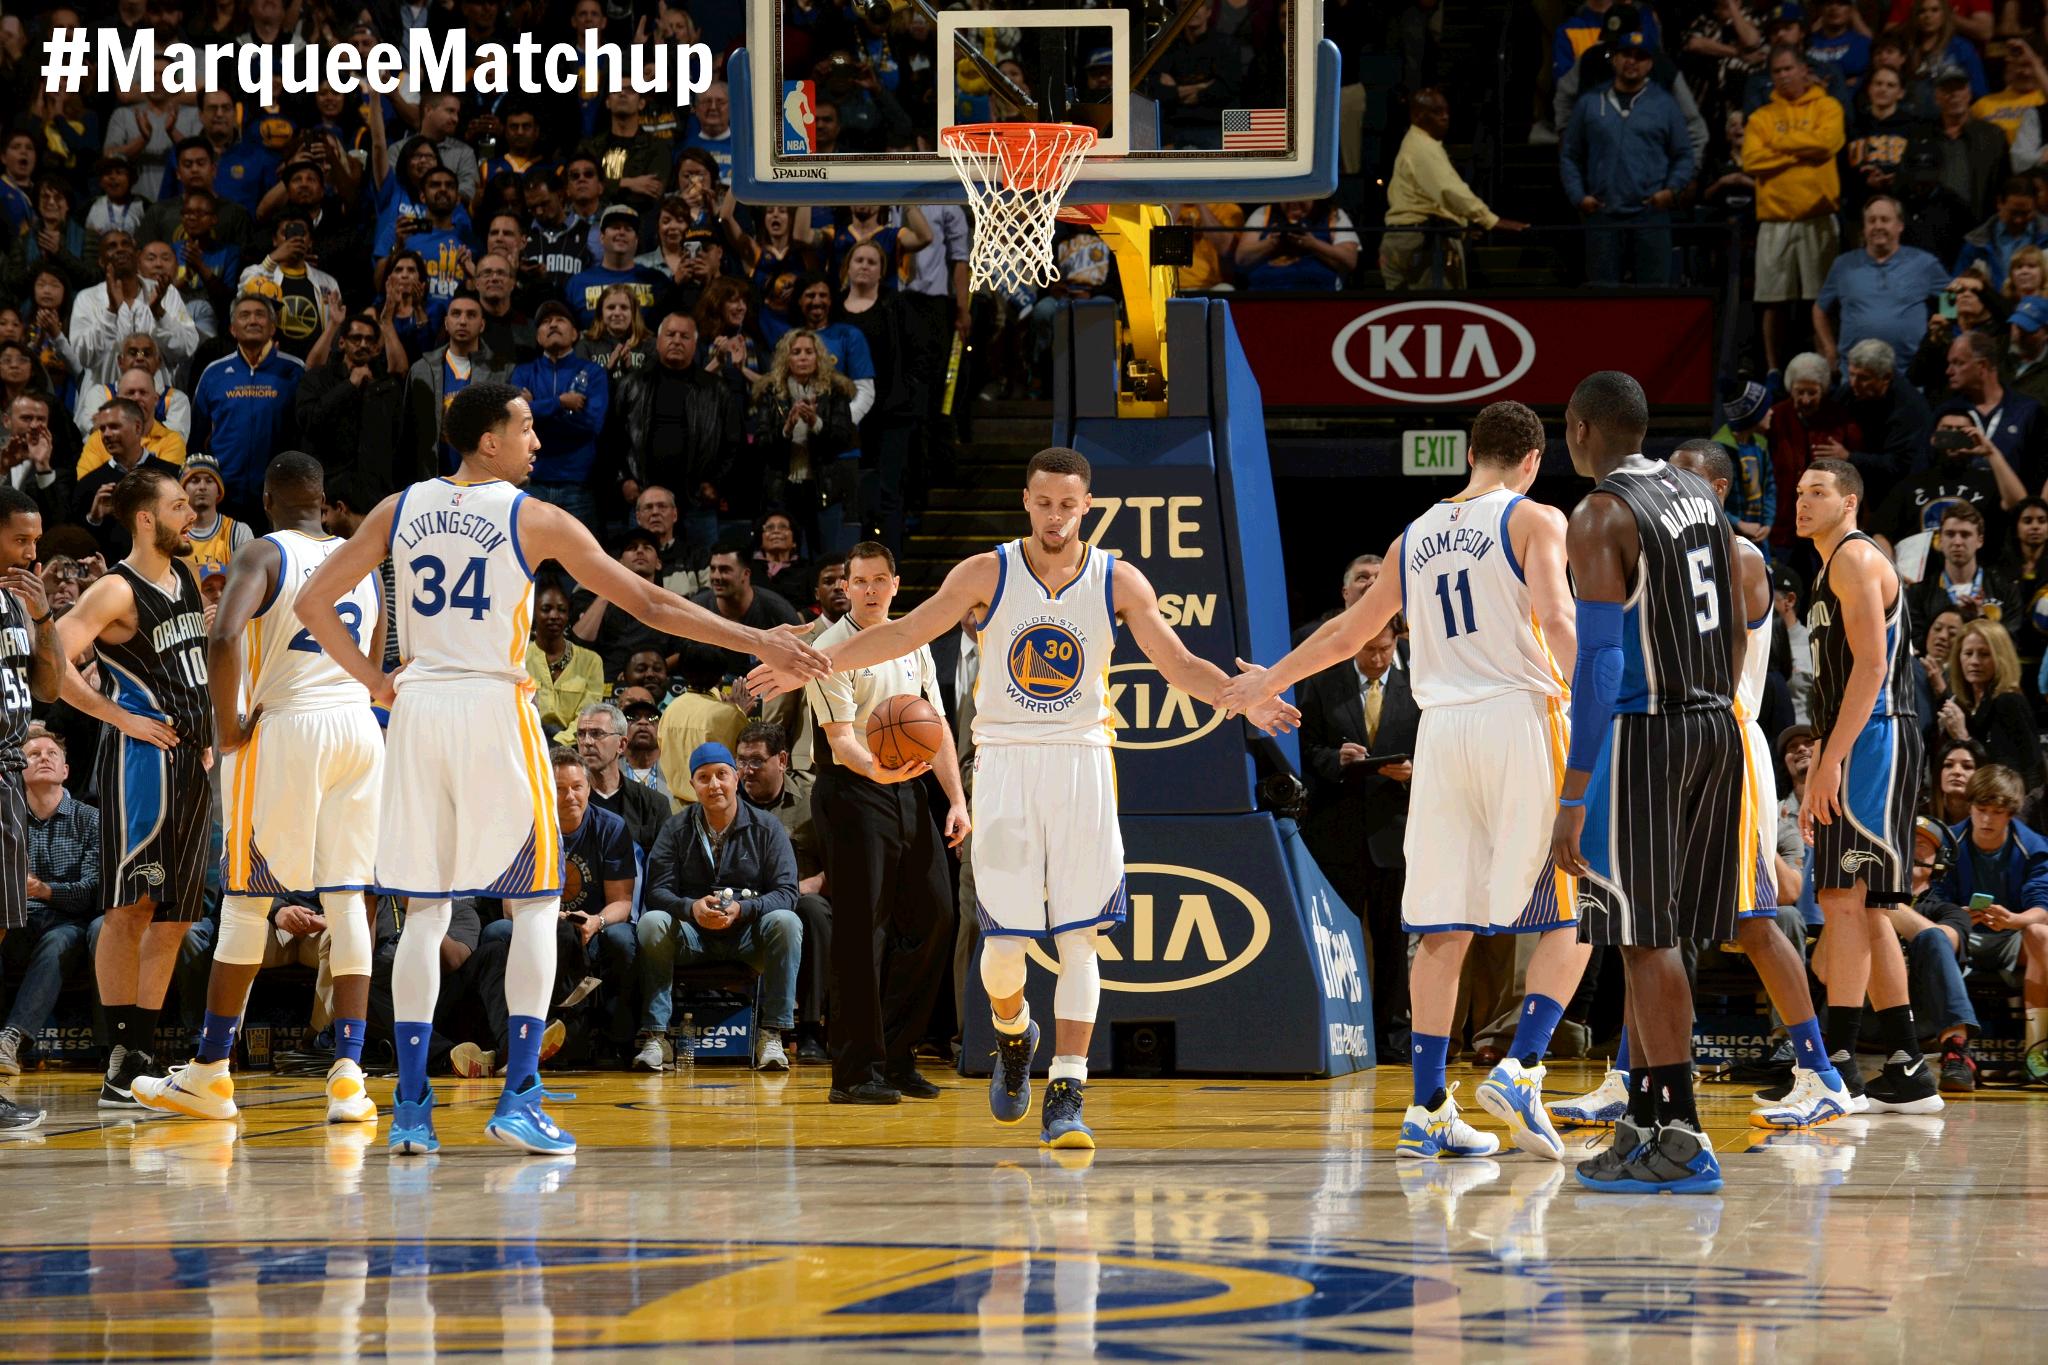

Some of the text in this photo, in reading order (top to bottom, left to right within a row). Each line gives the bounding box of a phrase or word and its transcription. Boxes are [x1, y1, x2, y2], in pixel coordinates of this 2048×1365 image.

[786, 140, 806, 151] NBA
[772, 167, 827, 180] SPALDING
[1367, 324, 1502, 379] KIA
[226, 389, 279, 399] WARRIORS
[1413, 435, 1458, 468] EXIT
[398, 510, 508, 553] LIVINGSTON
[1087, 496, 1204, 559] ZTE
[1660, 496, 1717, 540] OLADIPO
[1410, 528, 1495, 575] THOMPSON
[409, 554, 491, 621] 34
[1435, 568, 1479, 639] 11
[1686, 545, 1720, 634] 5
[1010, 615, 1089, 645] GOLDEN STATE
[1156, 594, 1218, 627] SN
[153, 611, 208, 654] ORLAND
[1043, 639, 1074, 661] 30
[2, 666, 33, 709] 55
[178, 646, 208, 688] 10
[1006, 683, 1083, 714] WARRIORS
[1695, 1047, 1763, 1058] PRESS
[1975, 1051, 2027, 1062] RESS
